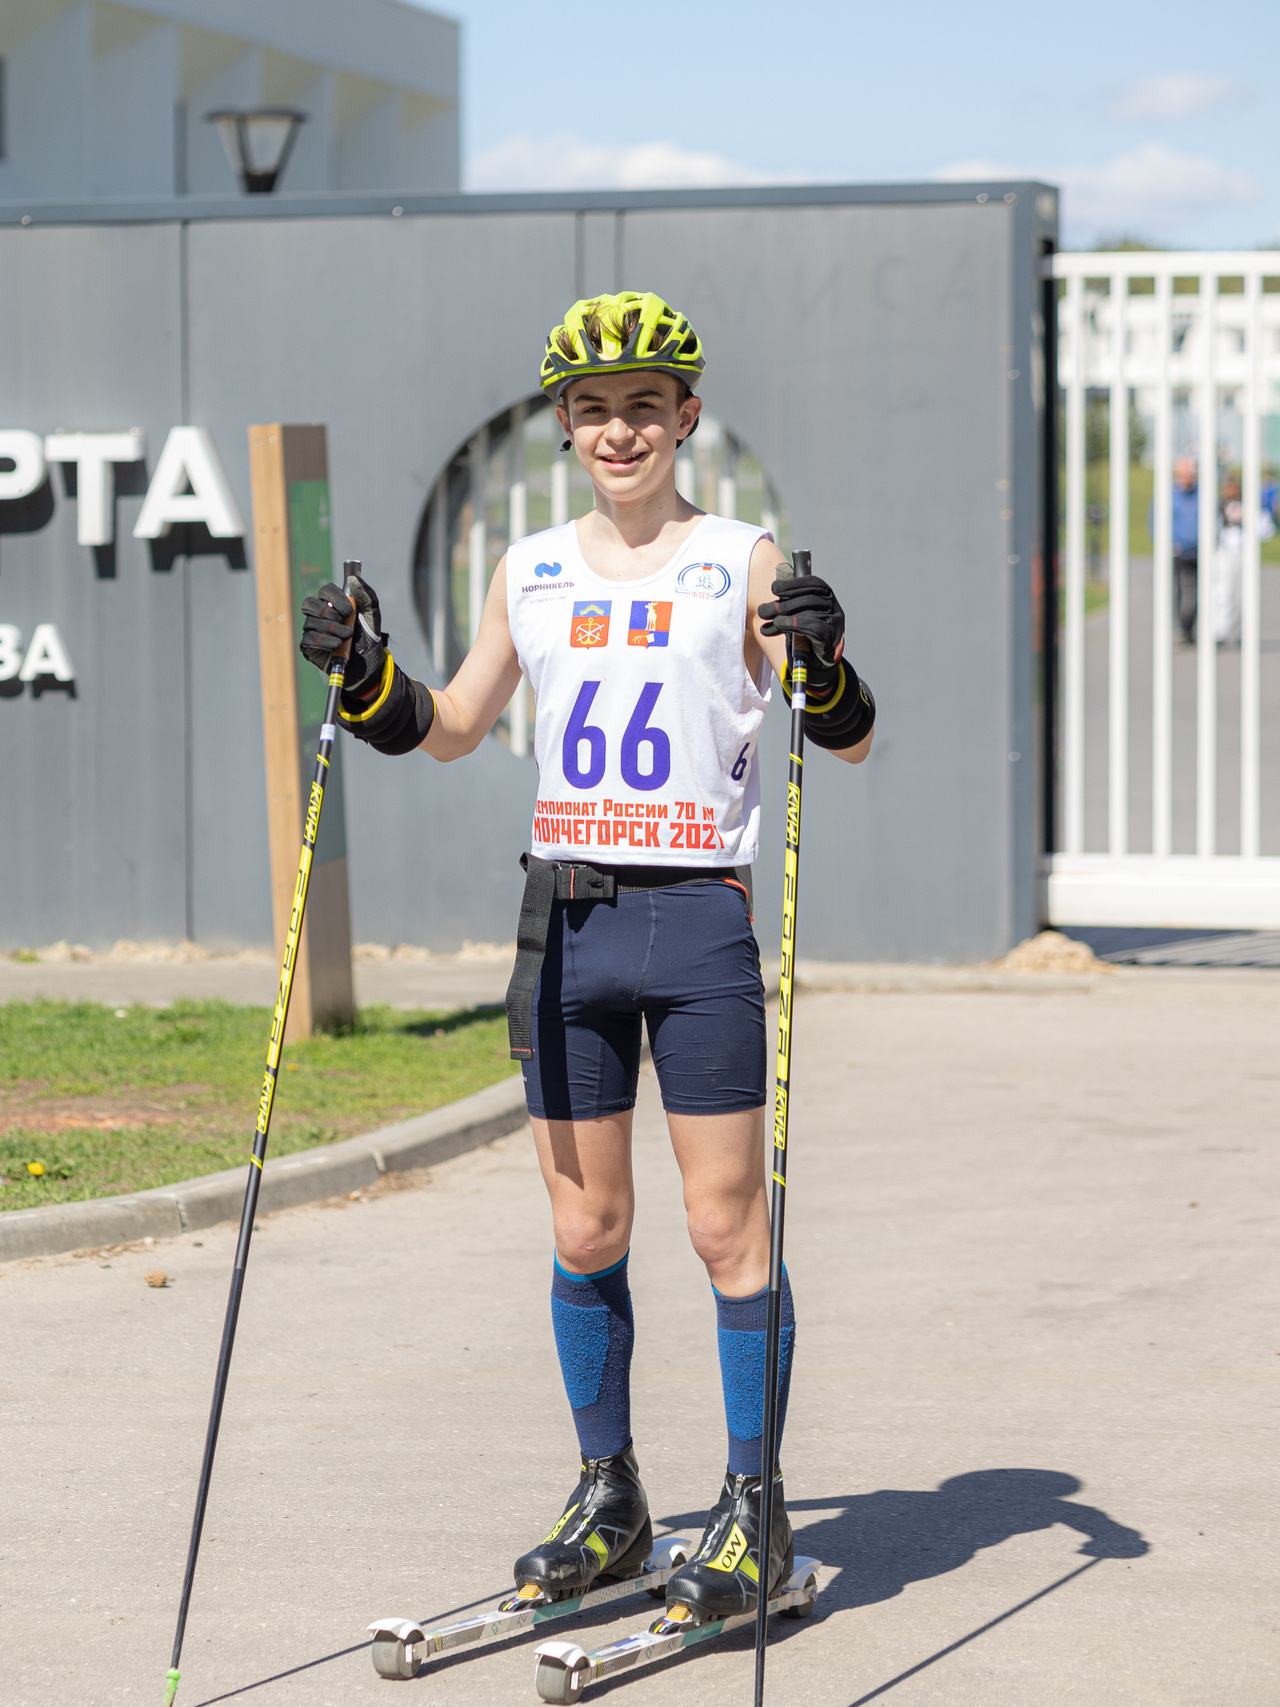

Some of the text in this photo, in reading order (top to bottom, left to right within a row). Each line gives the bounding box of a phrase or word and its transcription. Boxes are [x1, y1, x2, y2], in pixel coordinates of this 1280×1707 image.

[521, 581, 575, 593] НОРНИКЕЛЬ
[562, 680, 671, 791] 66
[674, 801, 696, 820] 70
[533, 816, 661, 848] МОНЧЕГОРСК
